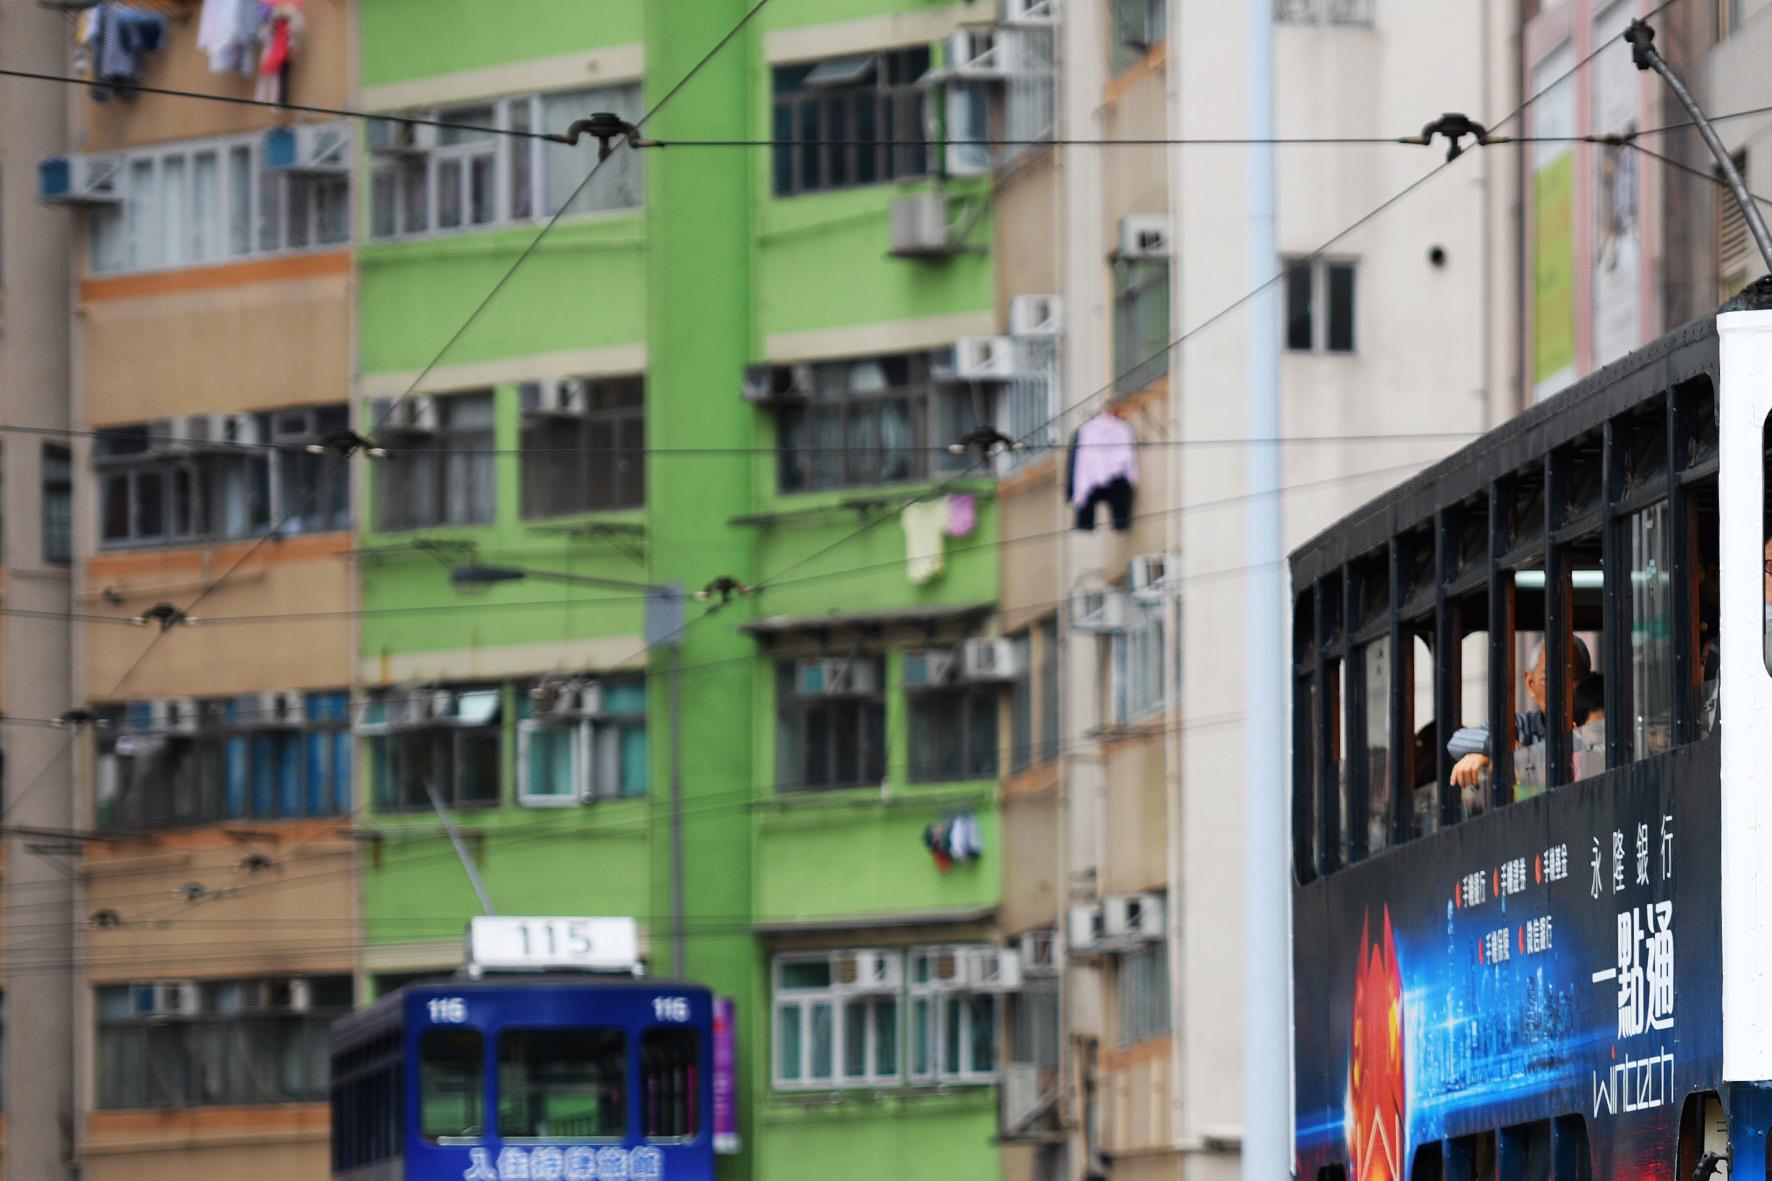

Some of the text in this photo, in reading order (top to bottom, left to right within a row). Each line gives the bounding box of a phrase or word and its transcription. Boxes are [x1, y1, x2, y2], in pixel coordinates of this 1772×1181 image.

[1590, 814, 1674, 899] 永隆銀行
[518, 920, 593, 956] 115
[1592, 900, 1675, 1039] 一點通
[1593, 1045, 1675, 1118] wintech
